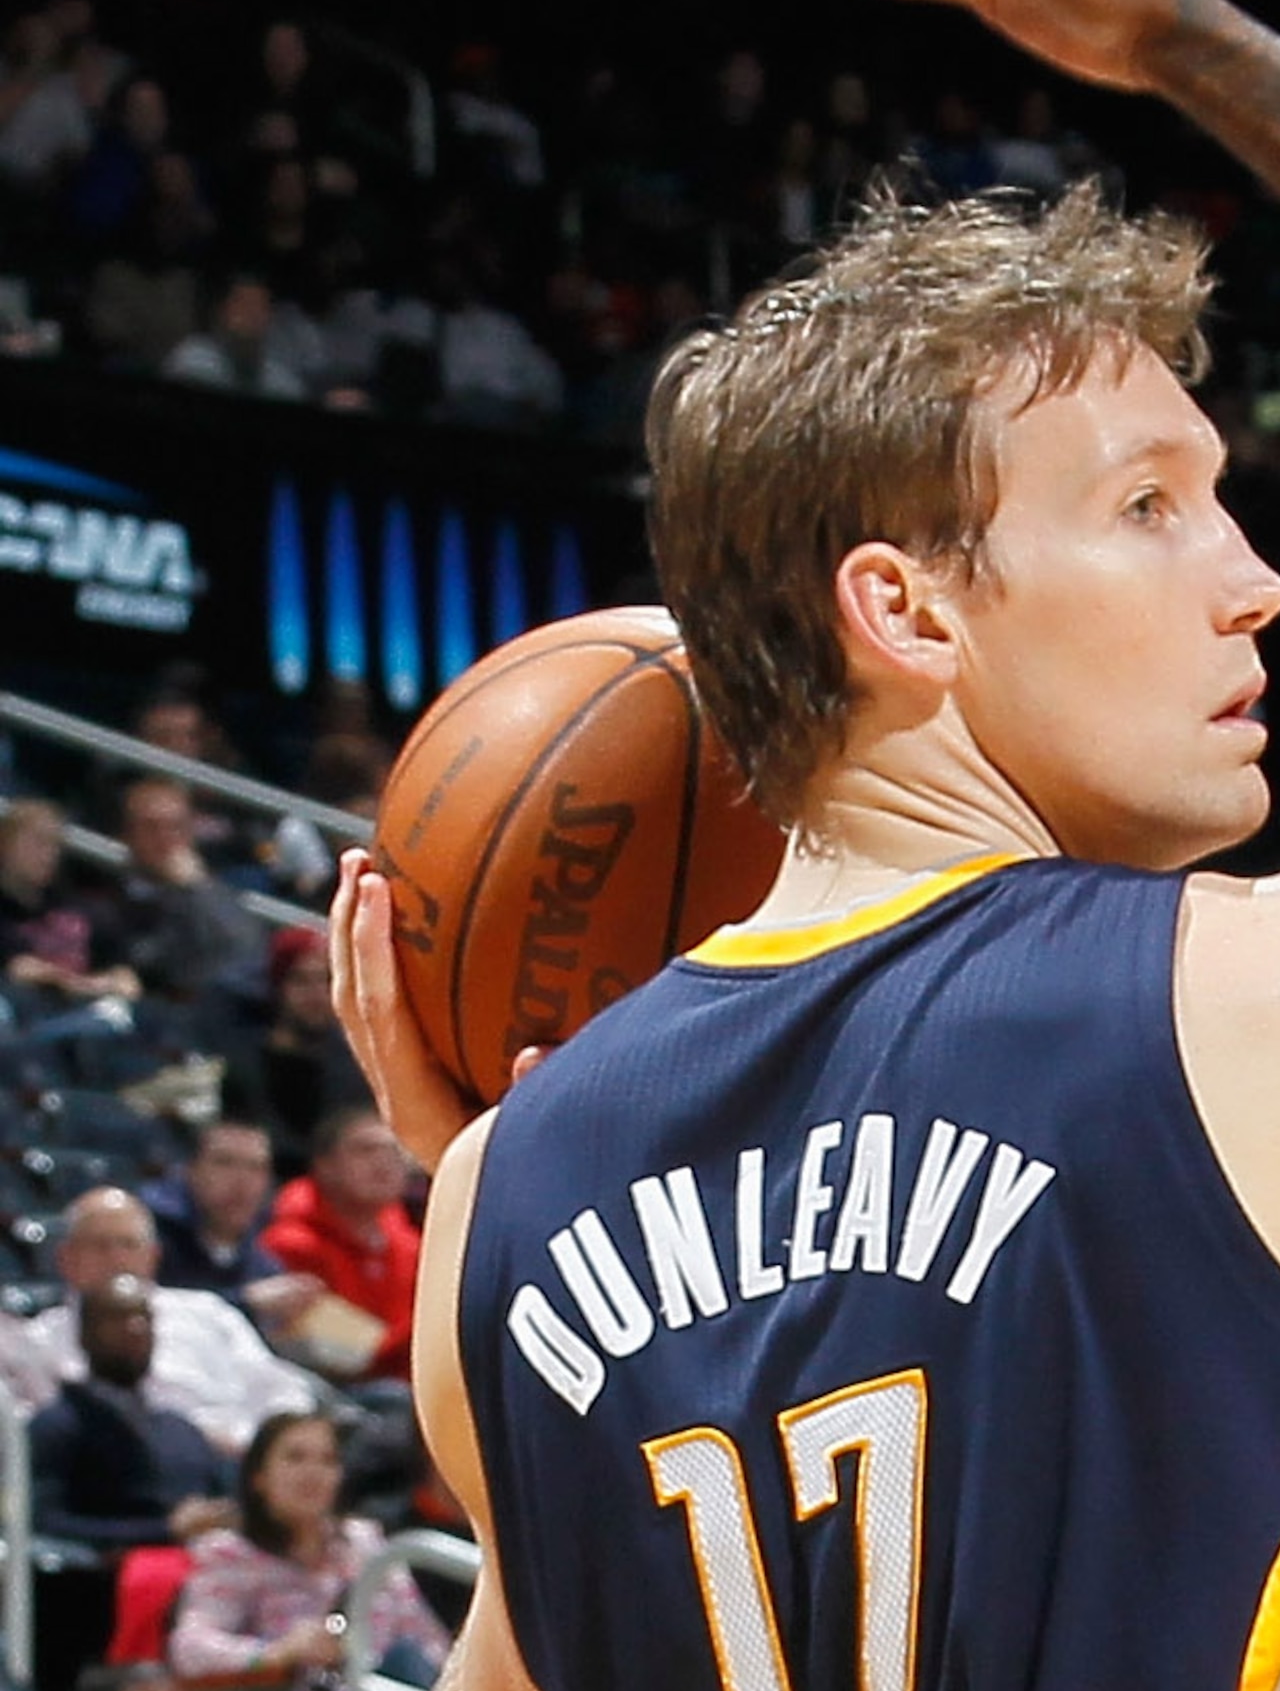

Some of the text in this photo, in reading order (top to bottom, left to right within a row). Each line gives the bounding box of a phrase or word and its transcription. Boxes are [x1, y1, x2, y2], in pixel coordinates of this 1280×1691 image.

[0, 493, 192, 592] CANA
[505, 780, 637, 1060] SPALD
[505, 1113, 1056, 1416] DUNLEAVY
